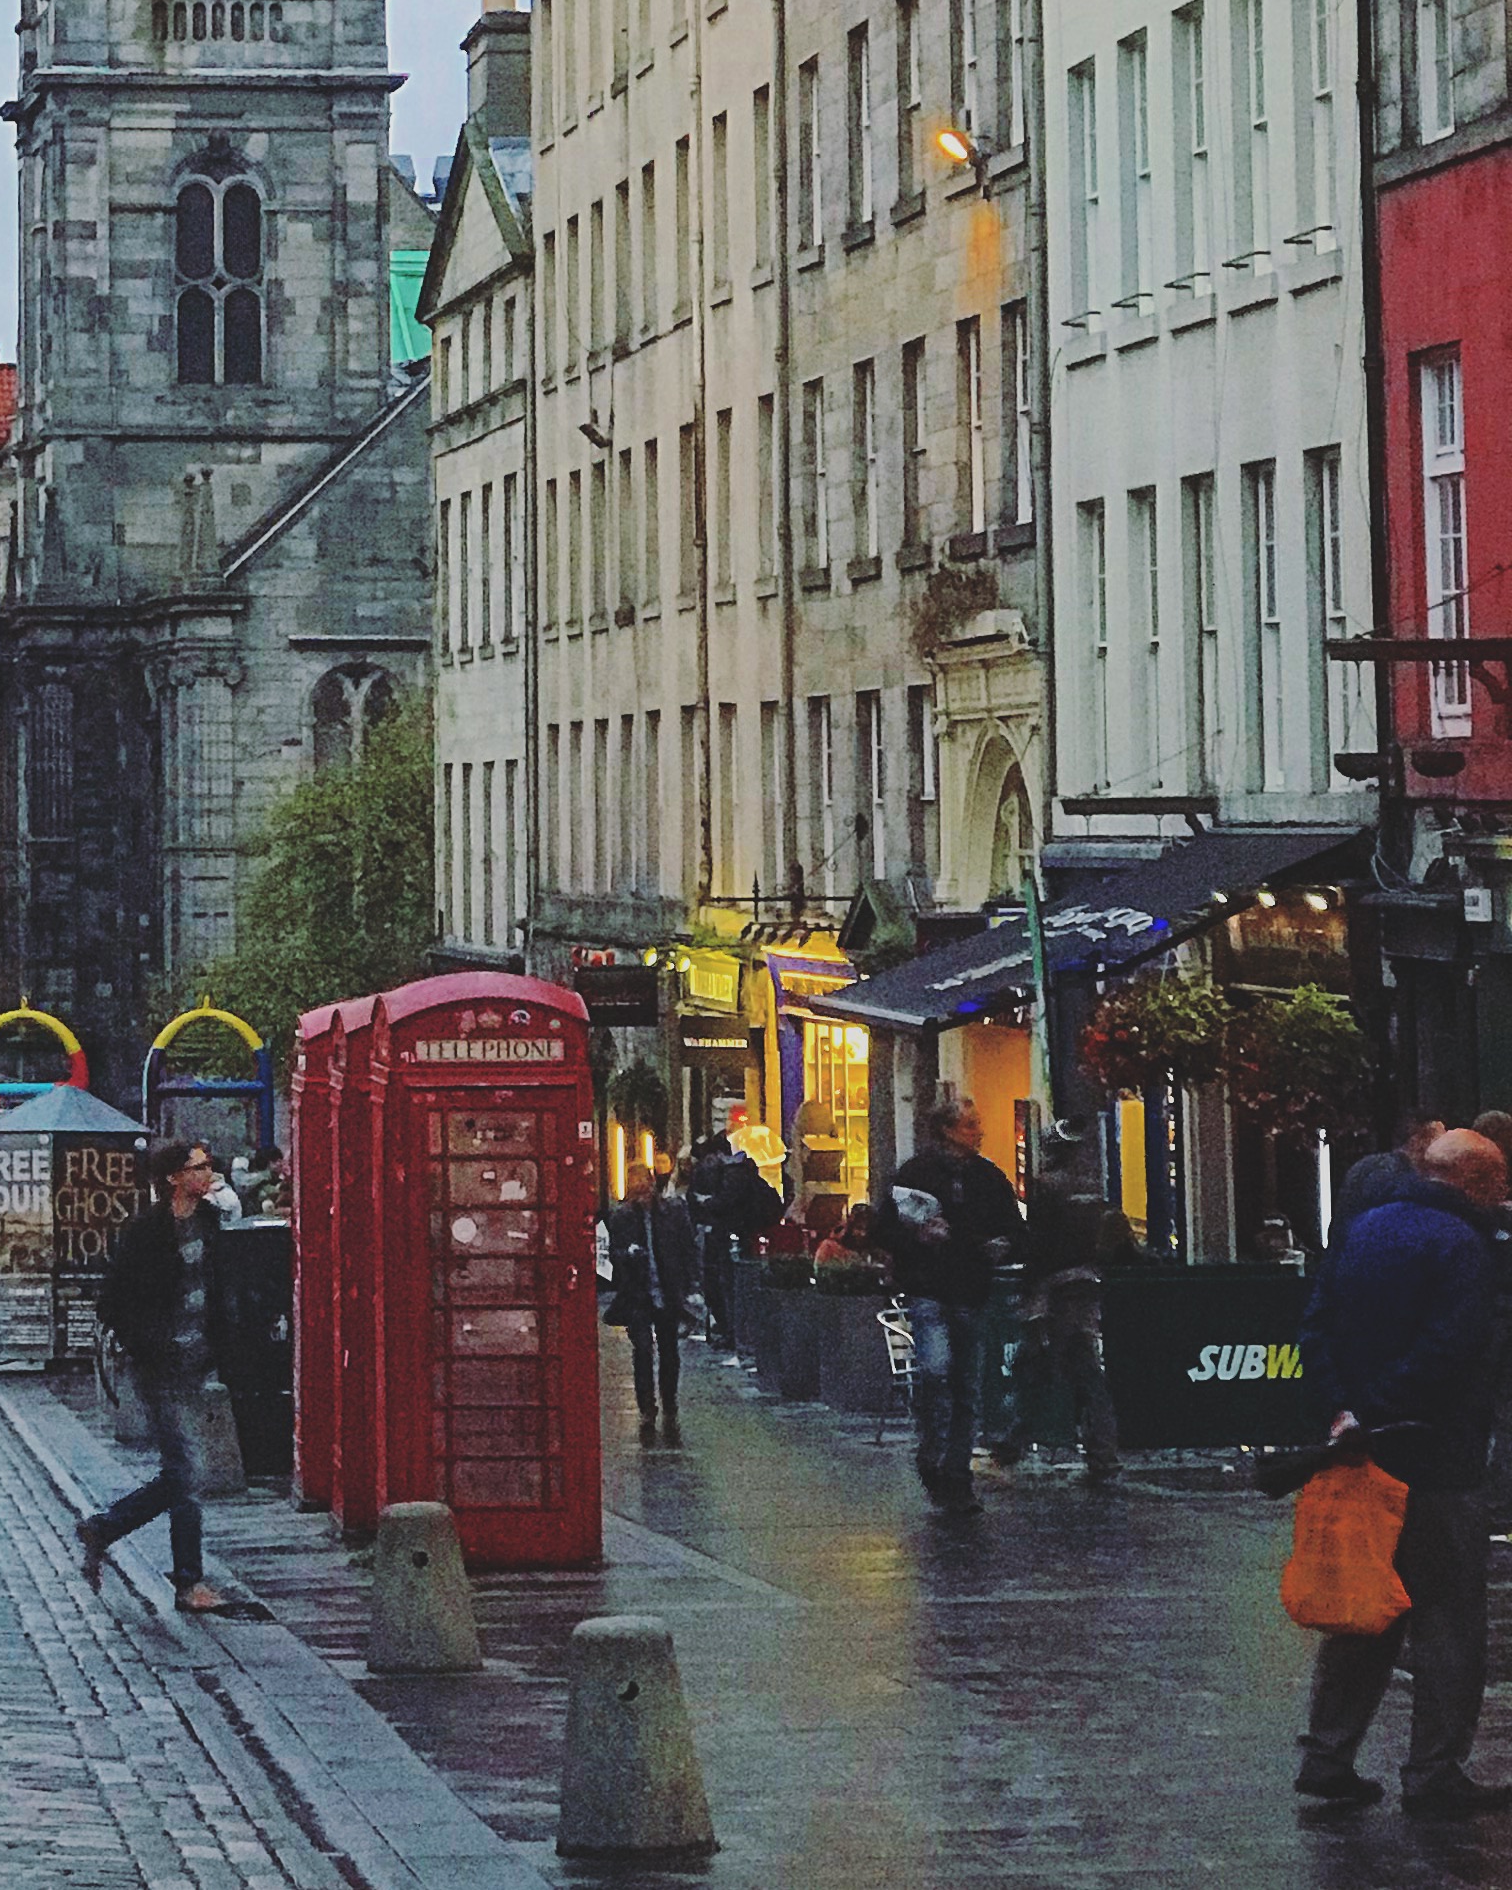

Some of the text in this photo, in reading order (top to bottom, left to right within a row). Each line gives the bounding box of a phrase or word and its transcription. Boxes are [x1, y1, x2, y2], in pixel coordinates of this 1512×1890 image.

[423, 1039, 561, 1060] TELEPHONE
[683, 1037, 748, 1049] WARHAMMER
[65, 1146, 136, 1188] FREE
[55, 1186, 147, 1224] GHOST
[59, 1226, 122, 1266] TOU
